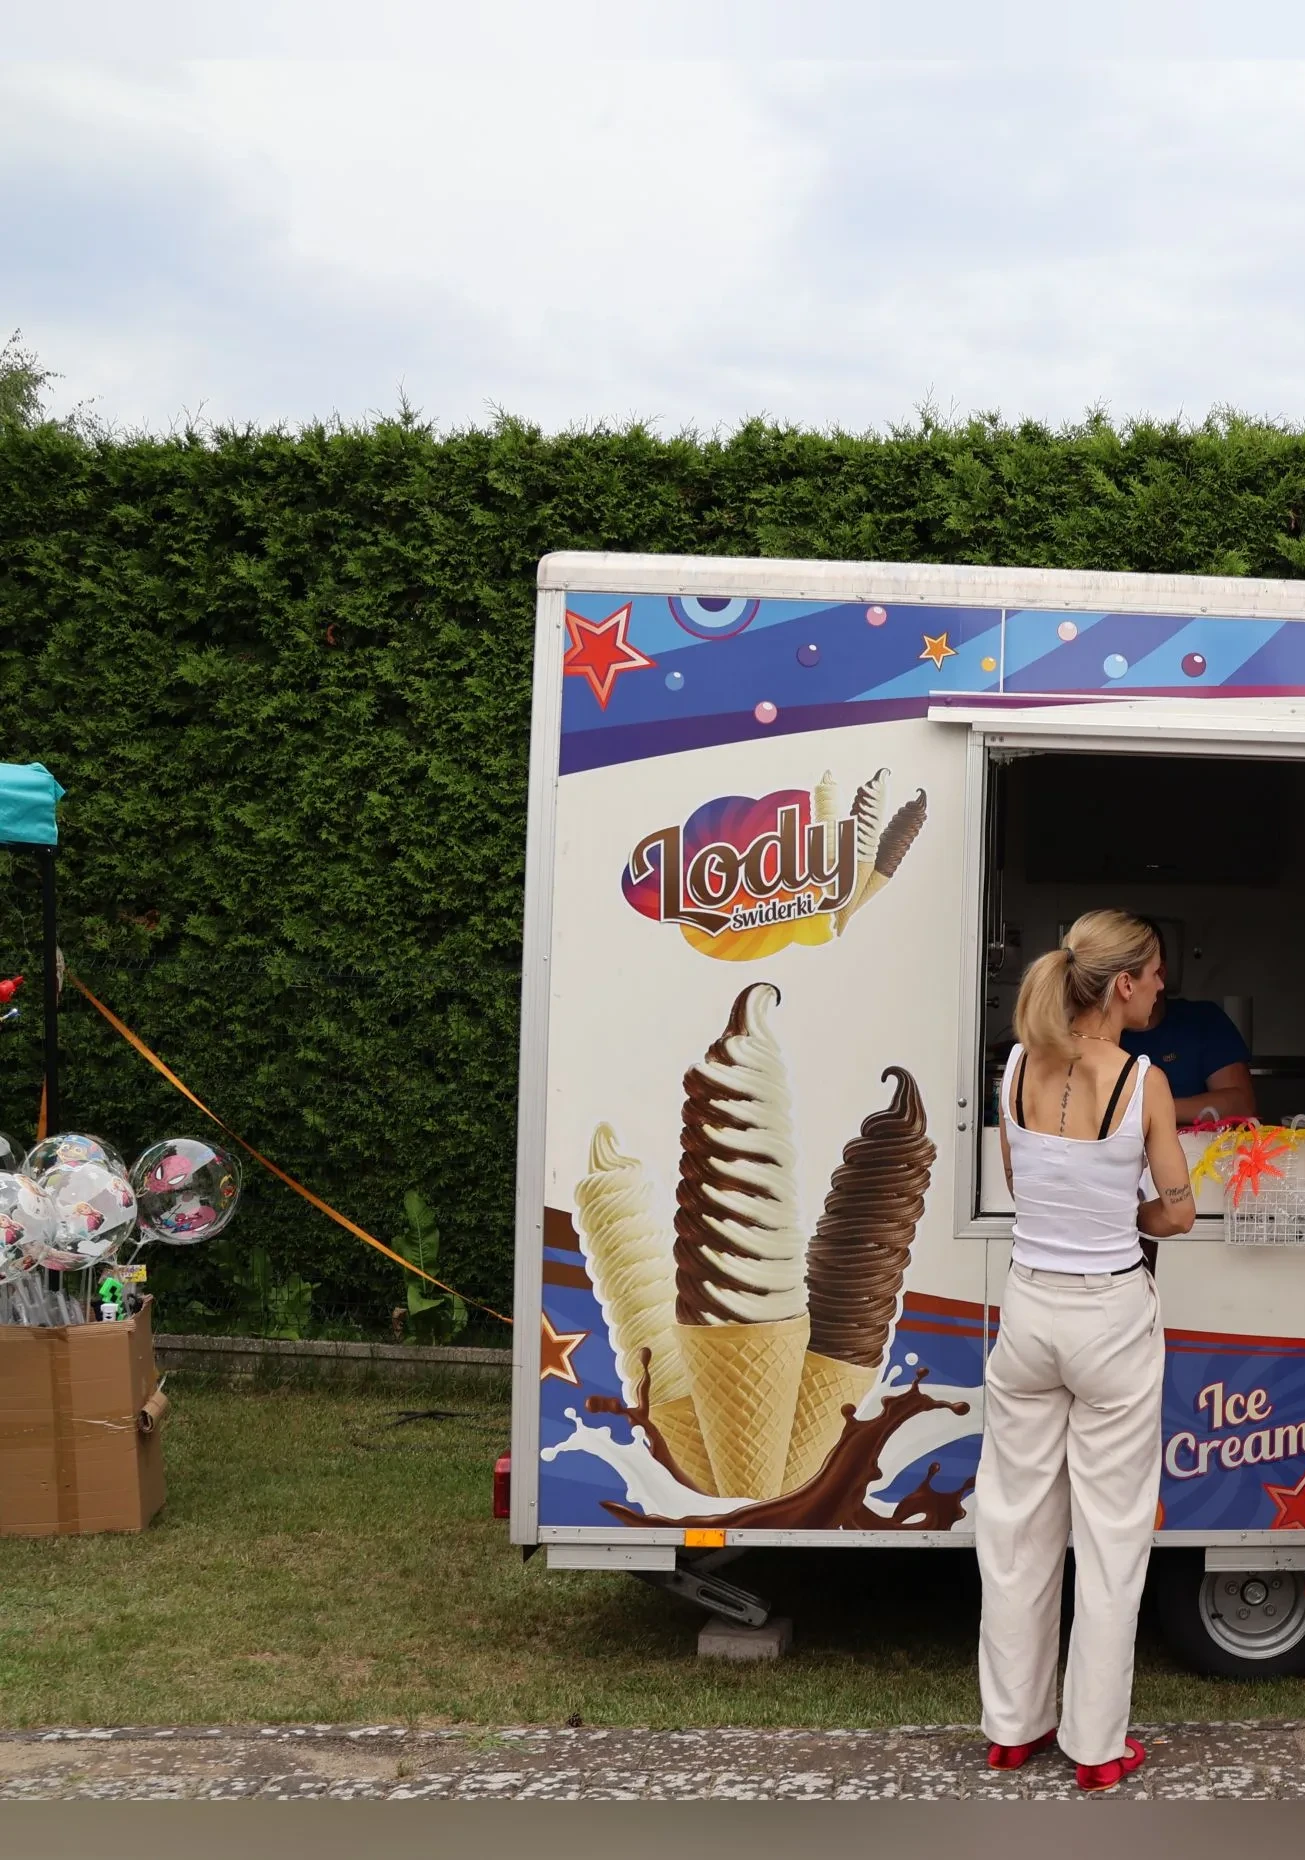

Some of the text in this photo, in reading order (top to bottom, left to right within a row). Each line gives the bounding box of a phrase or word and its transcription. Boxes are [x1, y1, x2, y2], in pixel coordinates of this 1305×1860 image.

[630, 805, 857, 936] Lody
[731, 892, 817, 930] świderki
[1199, 1382, 1272, 1429] Ice
